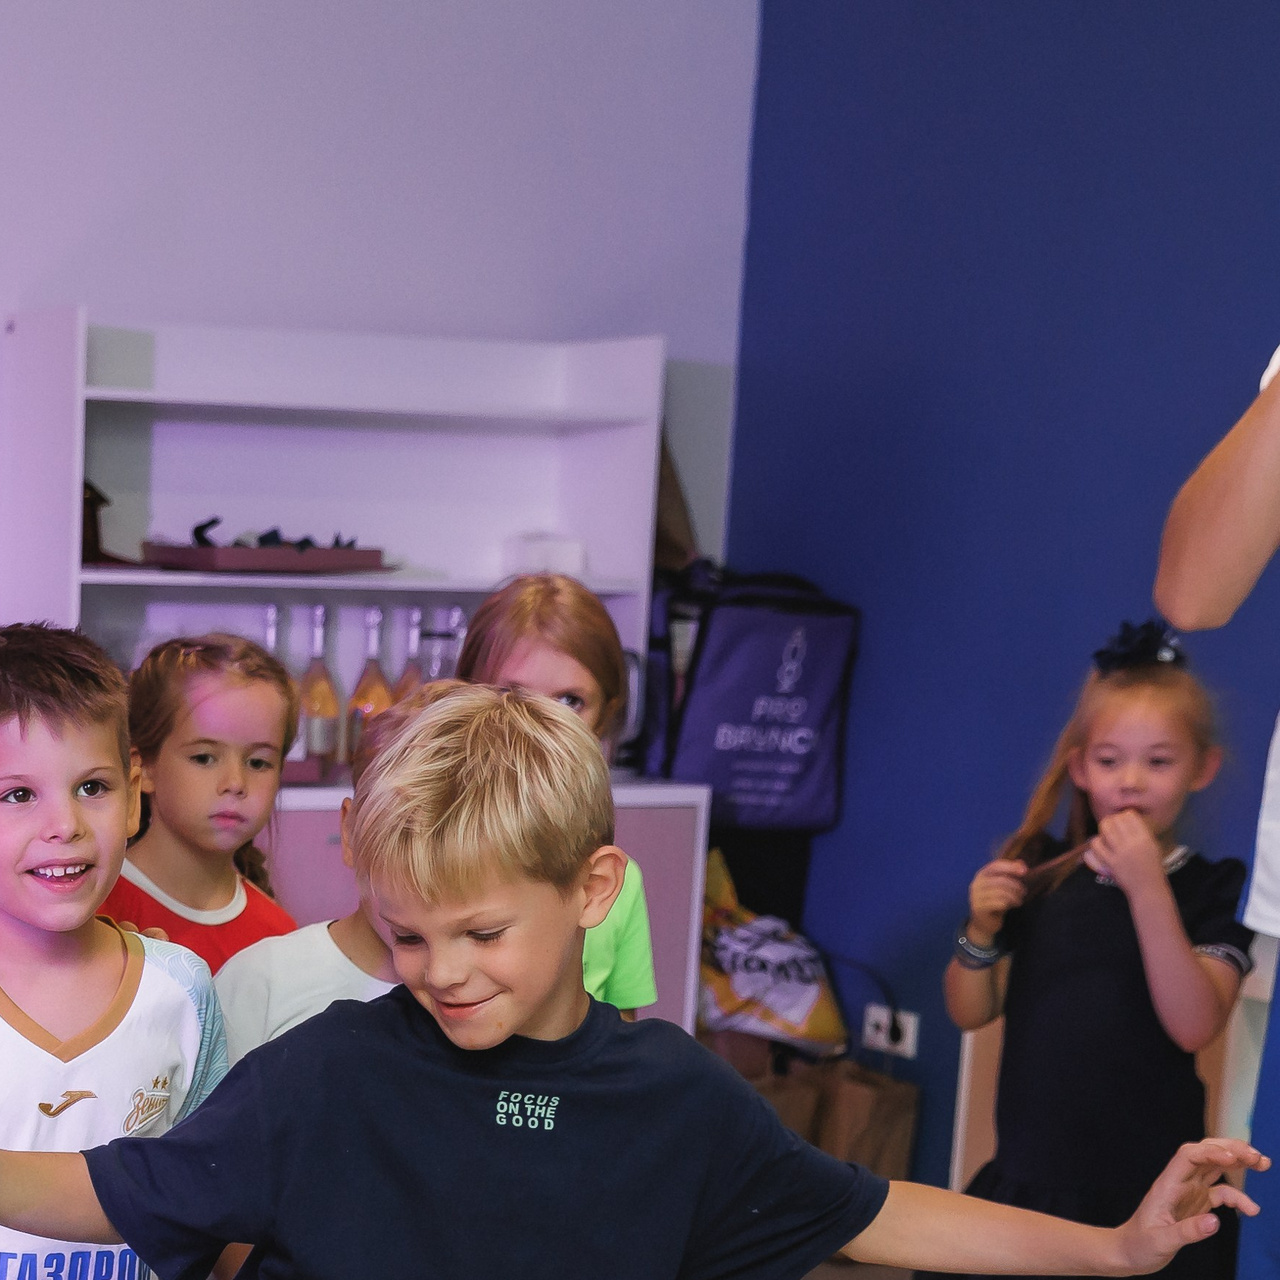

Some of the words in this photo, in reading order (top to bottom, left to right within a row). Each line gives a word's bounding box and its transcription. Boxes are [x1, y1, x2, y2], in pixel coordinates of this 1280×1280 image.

[498, 1090, 560, 1106] FOCUS
[496, 1101, 520, 1115] ON
[524, 1104, 556, 1118] THE
[495, 1113, 554, 1130] GOOD
